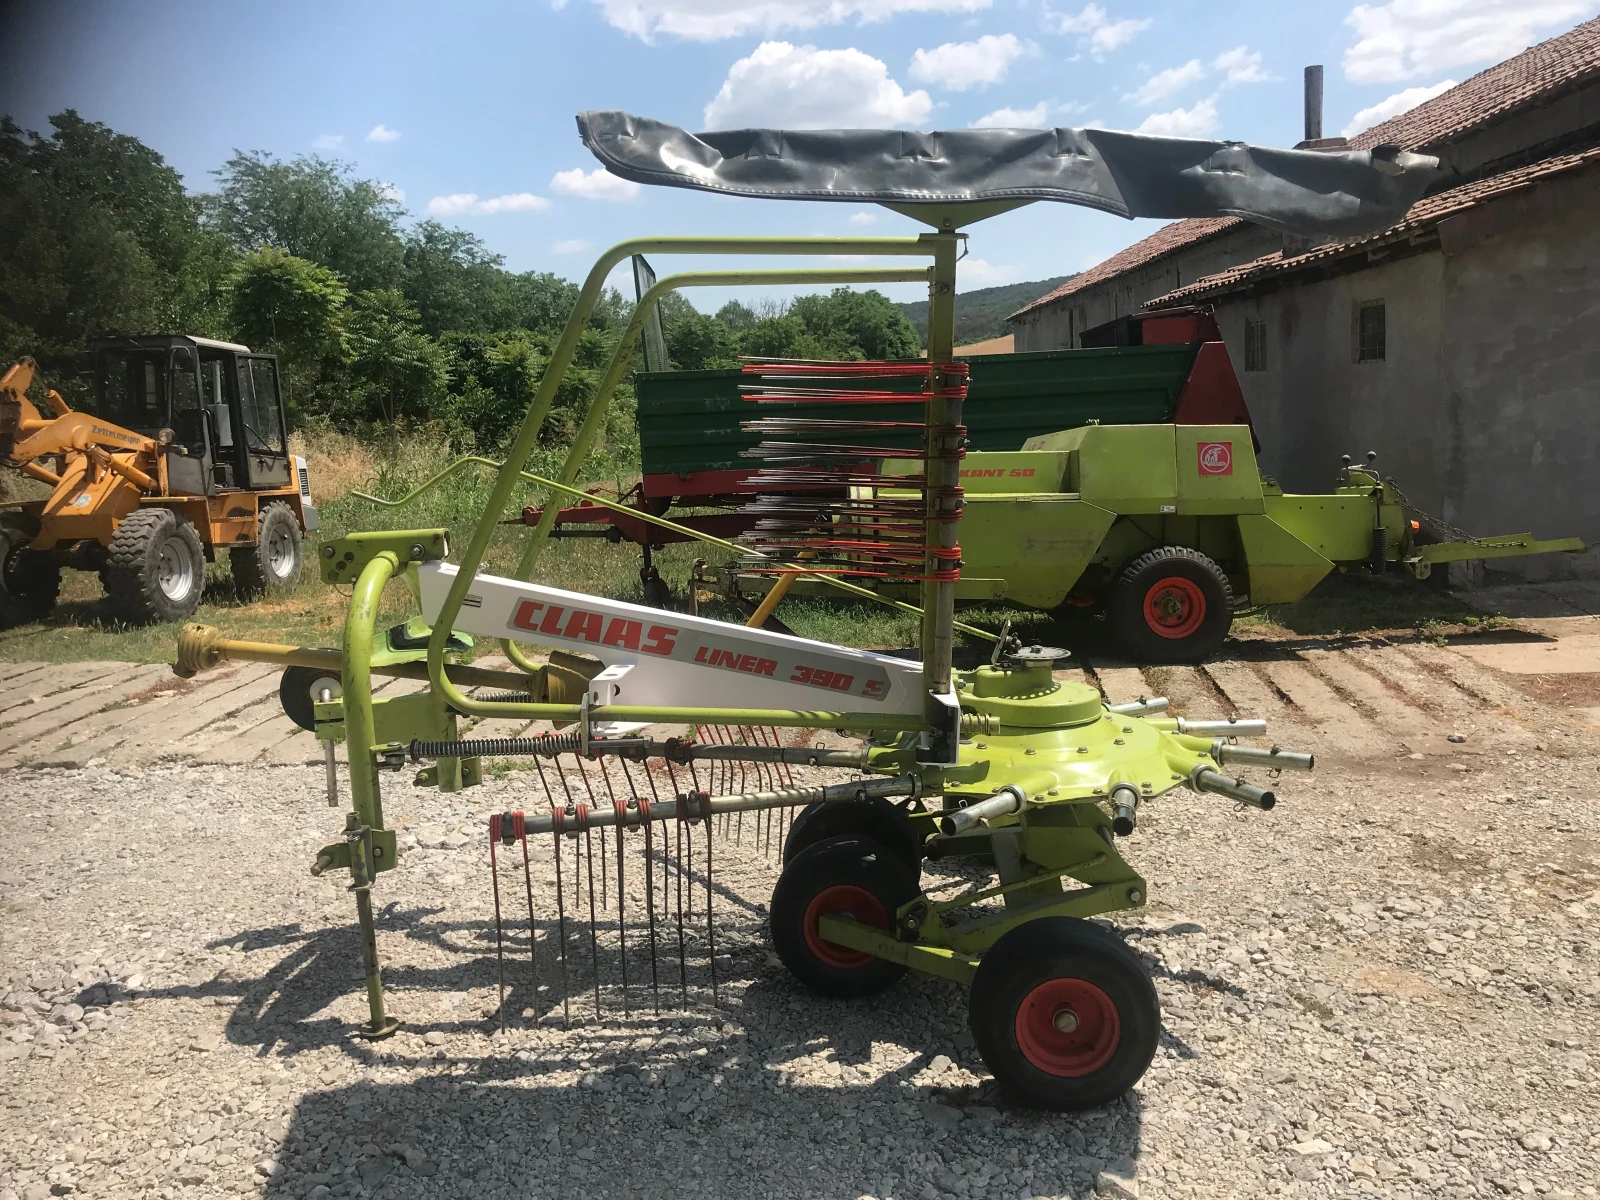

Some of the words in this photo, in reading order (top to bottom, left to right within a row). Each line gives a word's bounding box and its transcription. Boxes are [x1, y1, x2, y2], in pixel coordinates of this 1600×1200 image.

[1009, 468, 1035, 478] 50
[513, 600, 680, 656] CLAAS
[694, 646, 778, 677] LINER
[790, 665, 854, 692] 390
